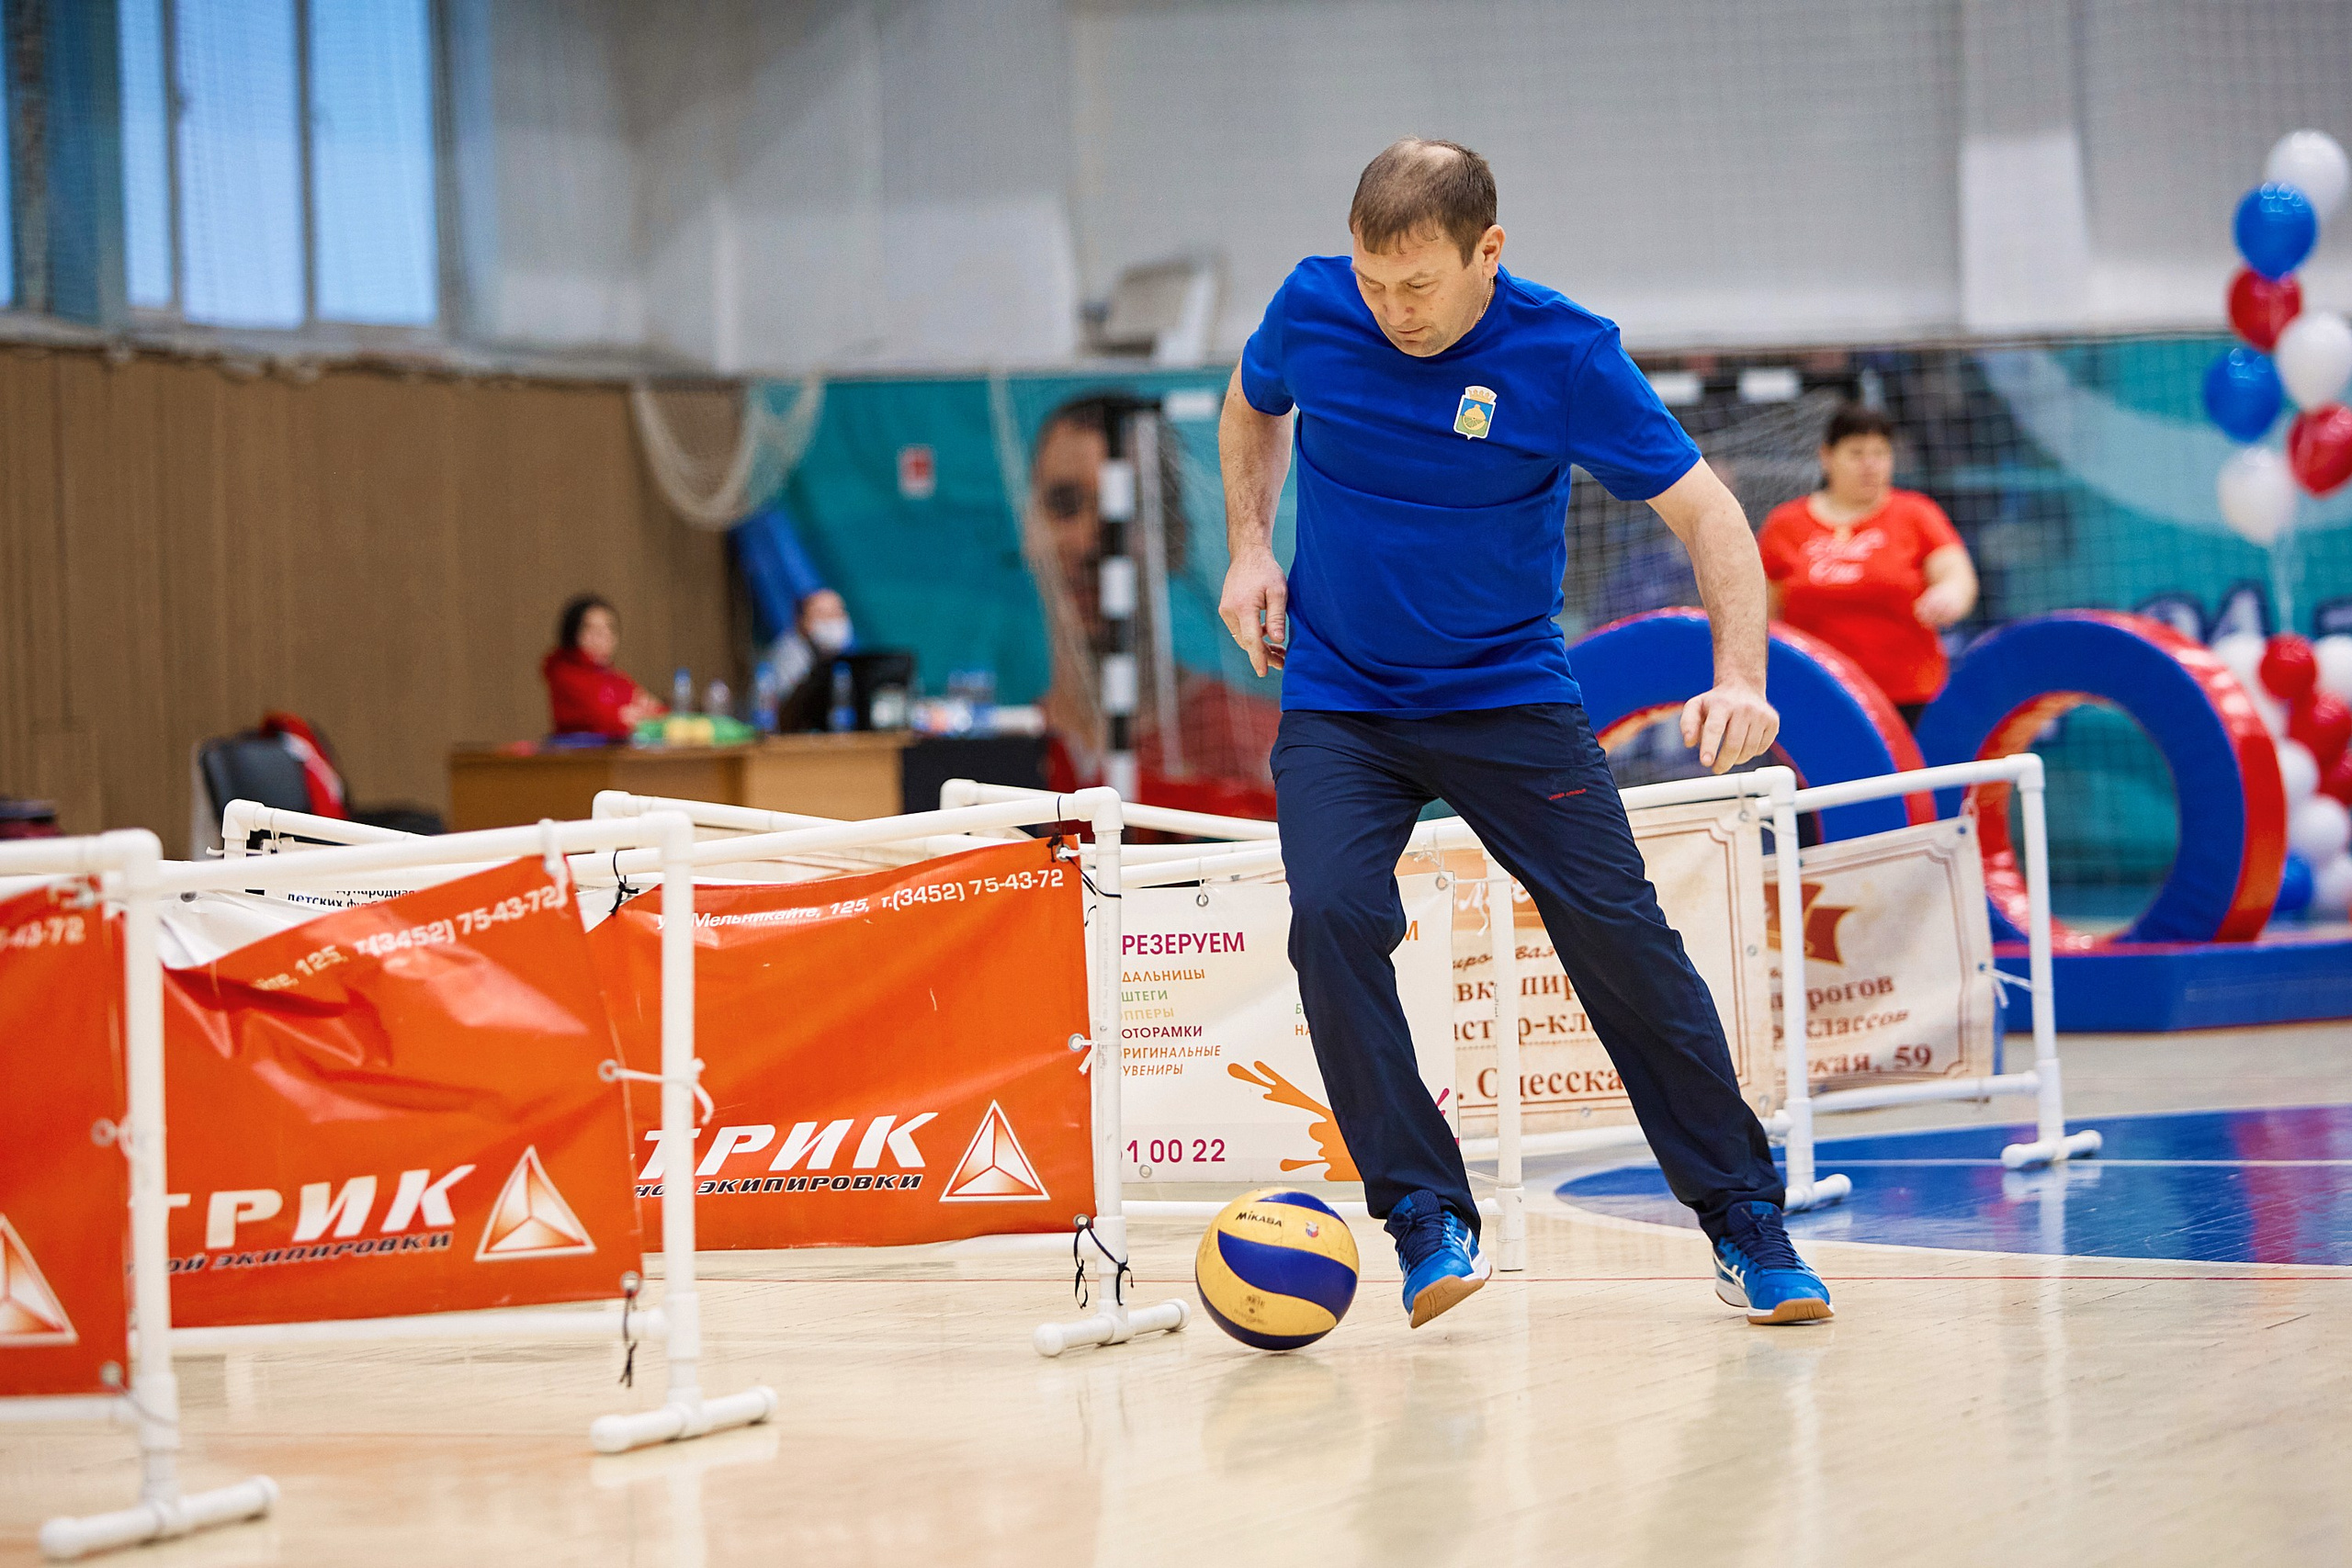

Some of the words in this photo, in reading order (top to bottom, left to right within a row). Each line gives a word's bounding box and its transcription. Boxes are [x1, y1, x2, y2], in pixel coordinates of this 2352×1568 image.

[691, 907, 820, 928] Мельникайте,
[830, 897, 869, 917] 125,
[969, 869, 1064, 896] 75-43-72
[1122, 931, 1245, 955] РЕЗЕРУЕМ
[1122, 969, 1205, 983] ДАЛЬНИЦЫ
[1121, 989, 1168, 1002] ШТЕГИ
[1121, 1025, 1203, 1039] ОТОРАМКИ
[1121, 1044, 1221, 1059] РИГИНАЛЬНЫЕ
[1121, 1064, 1183, 1077] УВЕНИРЫ
[639, 1112, 939, 1180] ТРИК
[1150, 1139, 1182, 1163] 00
[1193, 1138, 1226, 1162] 22
[696, 1174, 924, 1195] ЭКИПИРОВКИ
